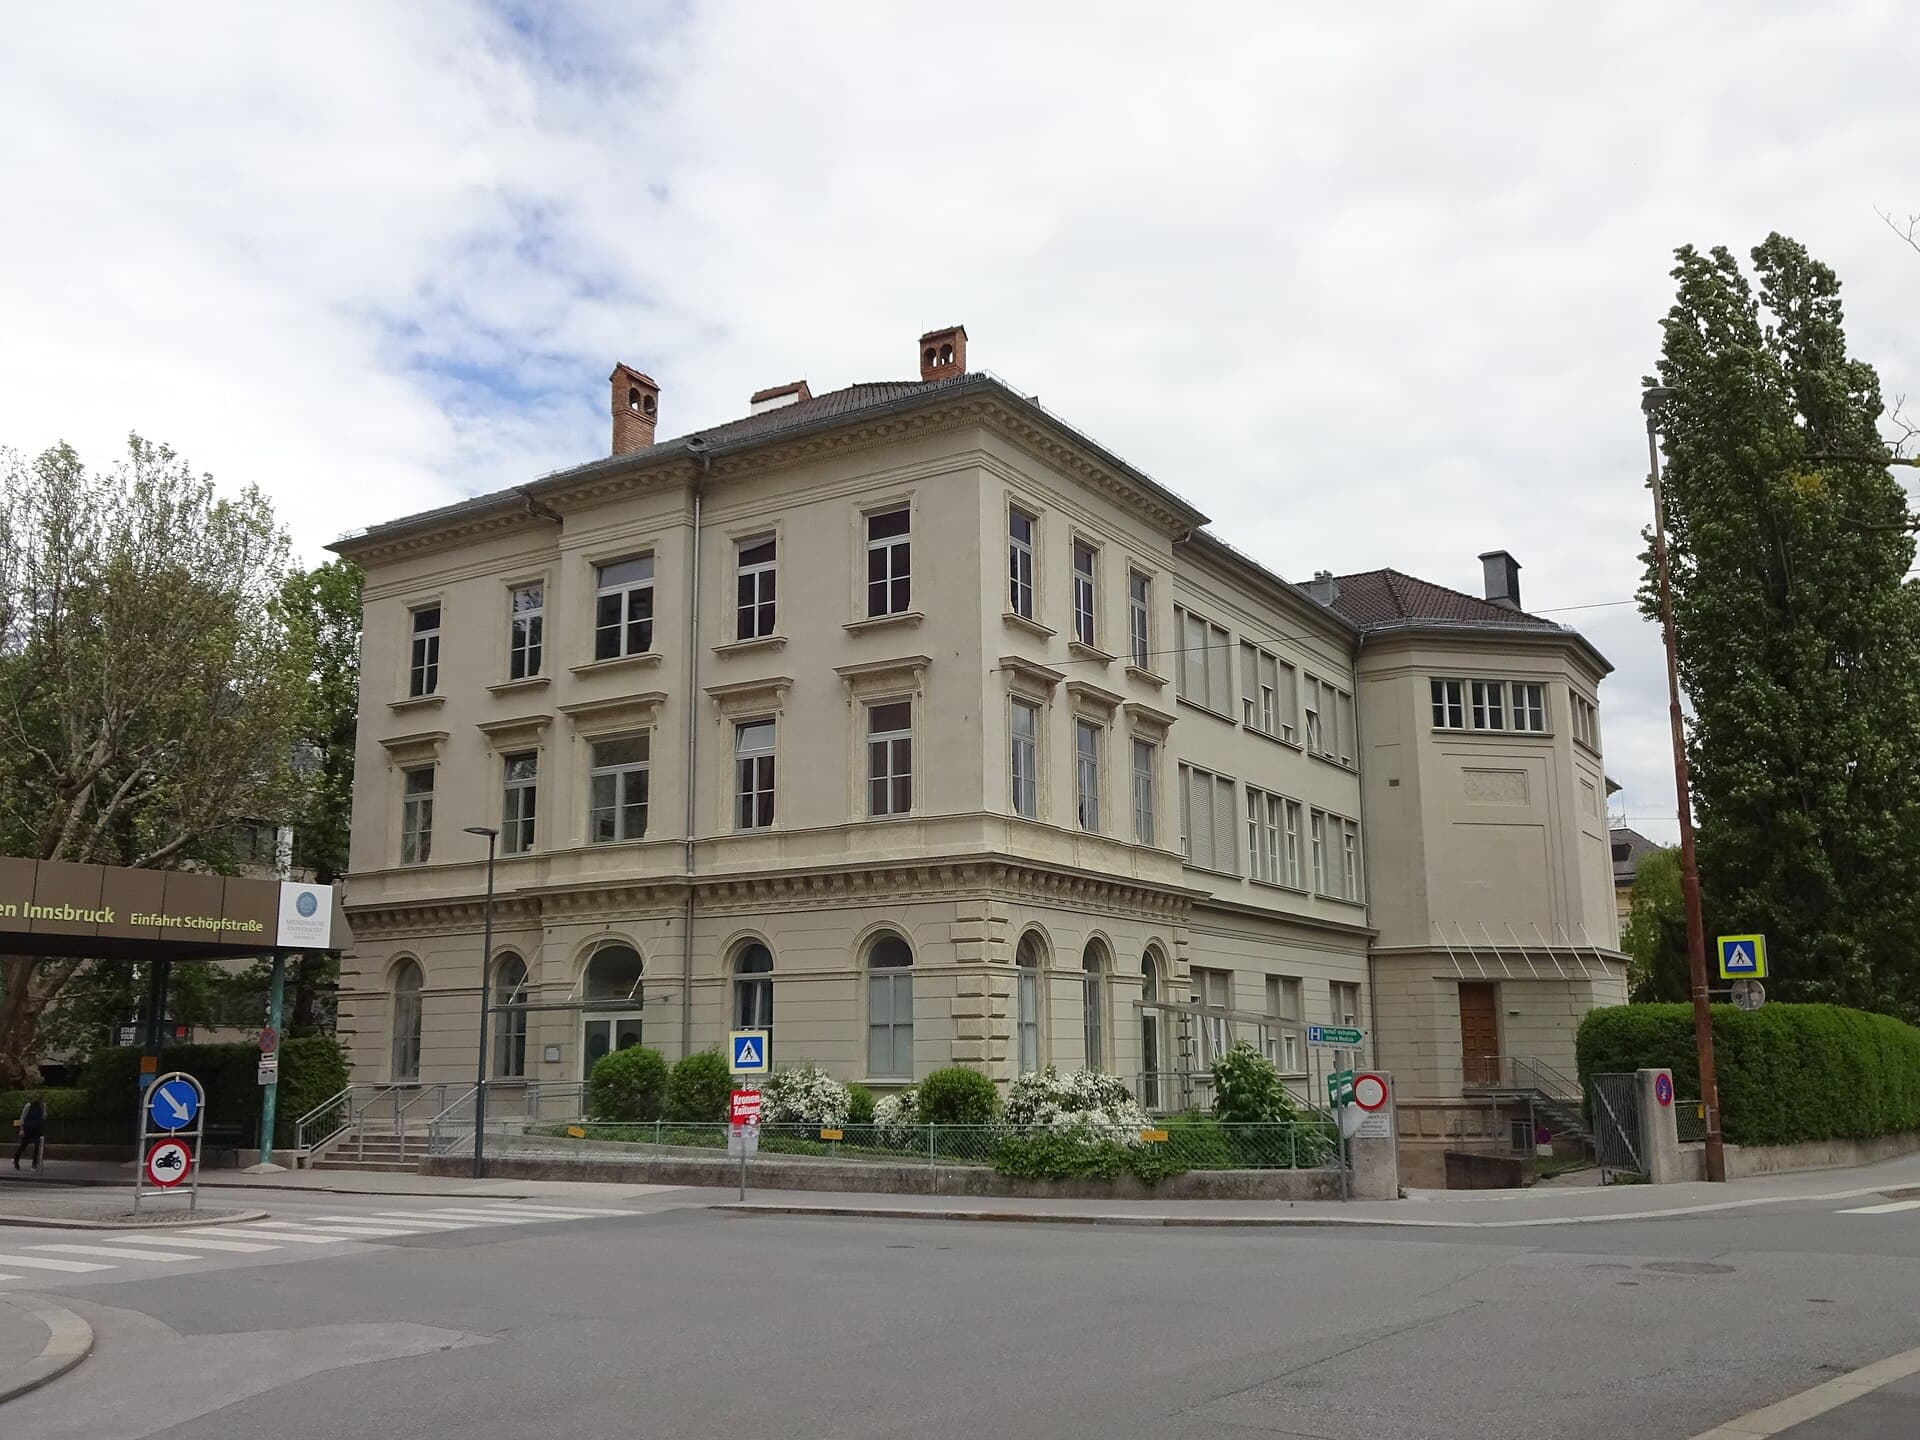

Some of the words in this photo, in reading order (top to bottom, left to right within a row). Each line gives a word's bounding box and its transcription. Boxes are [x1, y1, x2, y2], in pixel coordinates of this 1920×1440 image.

[23, 902, 115, 923] Innsbruck
[130, 912, 182, 928] Einfahrt
[184, 916, 264, 932] Schöpfstraße
[1310, 1027, 1321, 1040] H
[733, 1094, 760, 1105] Kronen
